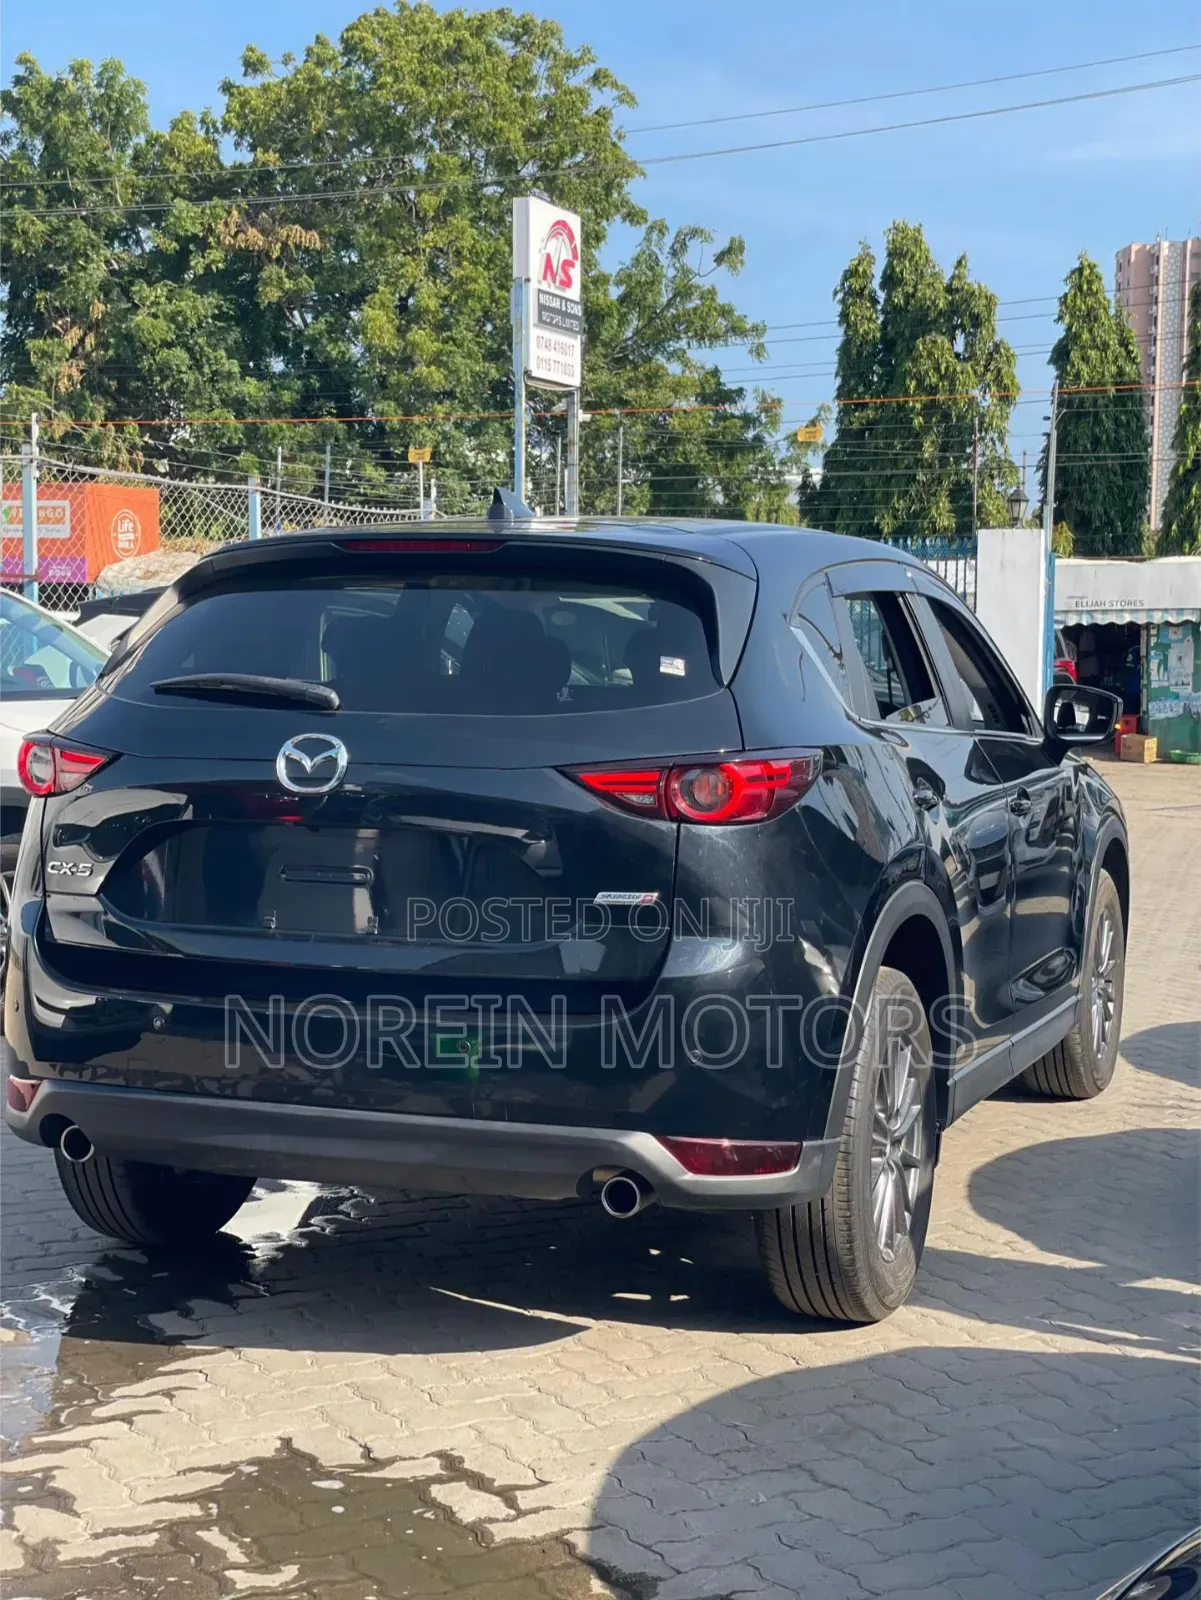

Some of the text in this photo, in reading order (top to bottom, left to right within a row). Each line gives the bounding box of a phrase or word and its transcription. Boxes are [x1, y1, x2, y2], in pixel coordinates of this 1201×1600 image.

[539, 292, 582, 317] NISSAR & SONS
[536, 335, 552, 352] 0748
[536, 355, 552, 372] 0115
[118, 518, 134, 533] Life
[1075, 599, 1145, 608] ELIJAH STORES
[47, 861, 93, 877] CX-5
